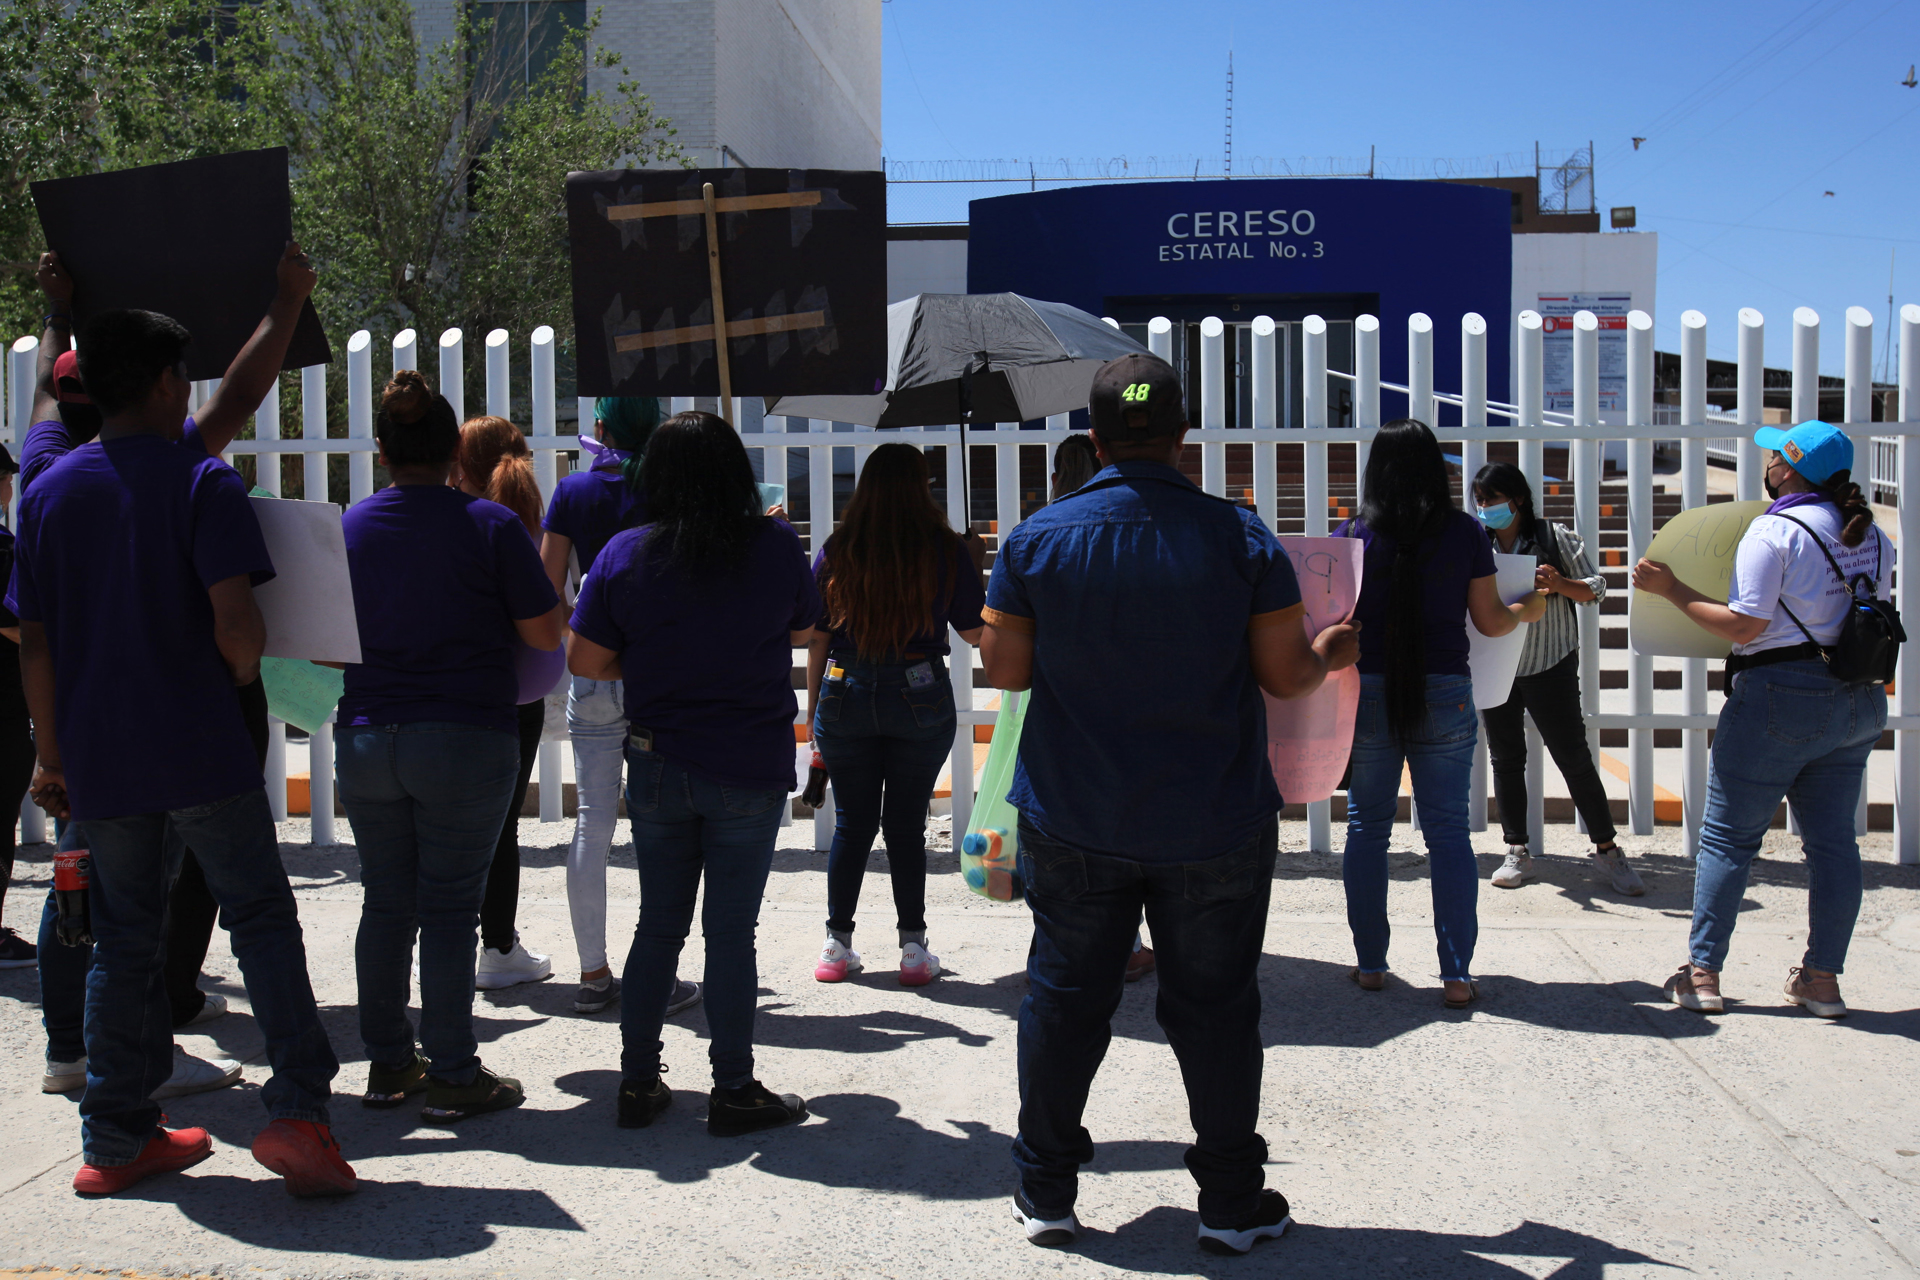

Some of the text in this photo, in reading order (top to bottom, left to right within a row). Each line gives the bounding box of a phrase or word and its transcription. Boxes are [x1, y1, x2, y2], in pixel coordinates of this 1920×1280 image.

[1167, 209, 1316, 239] CERESO
[1159, 240, 1325, 262] ESTATAL No.3
[1122, 383, 1151, 402] 48
[1844, 562, 1852, 570] su
[1853, 558, 1871, 568] alma
